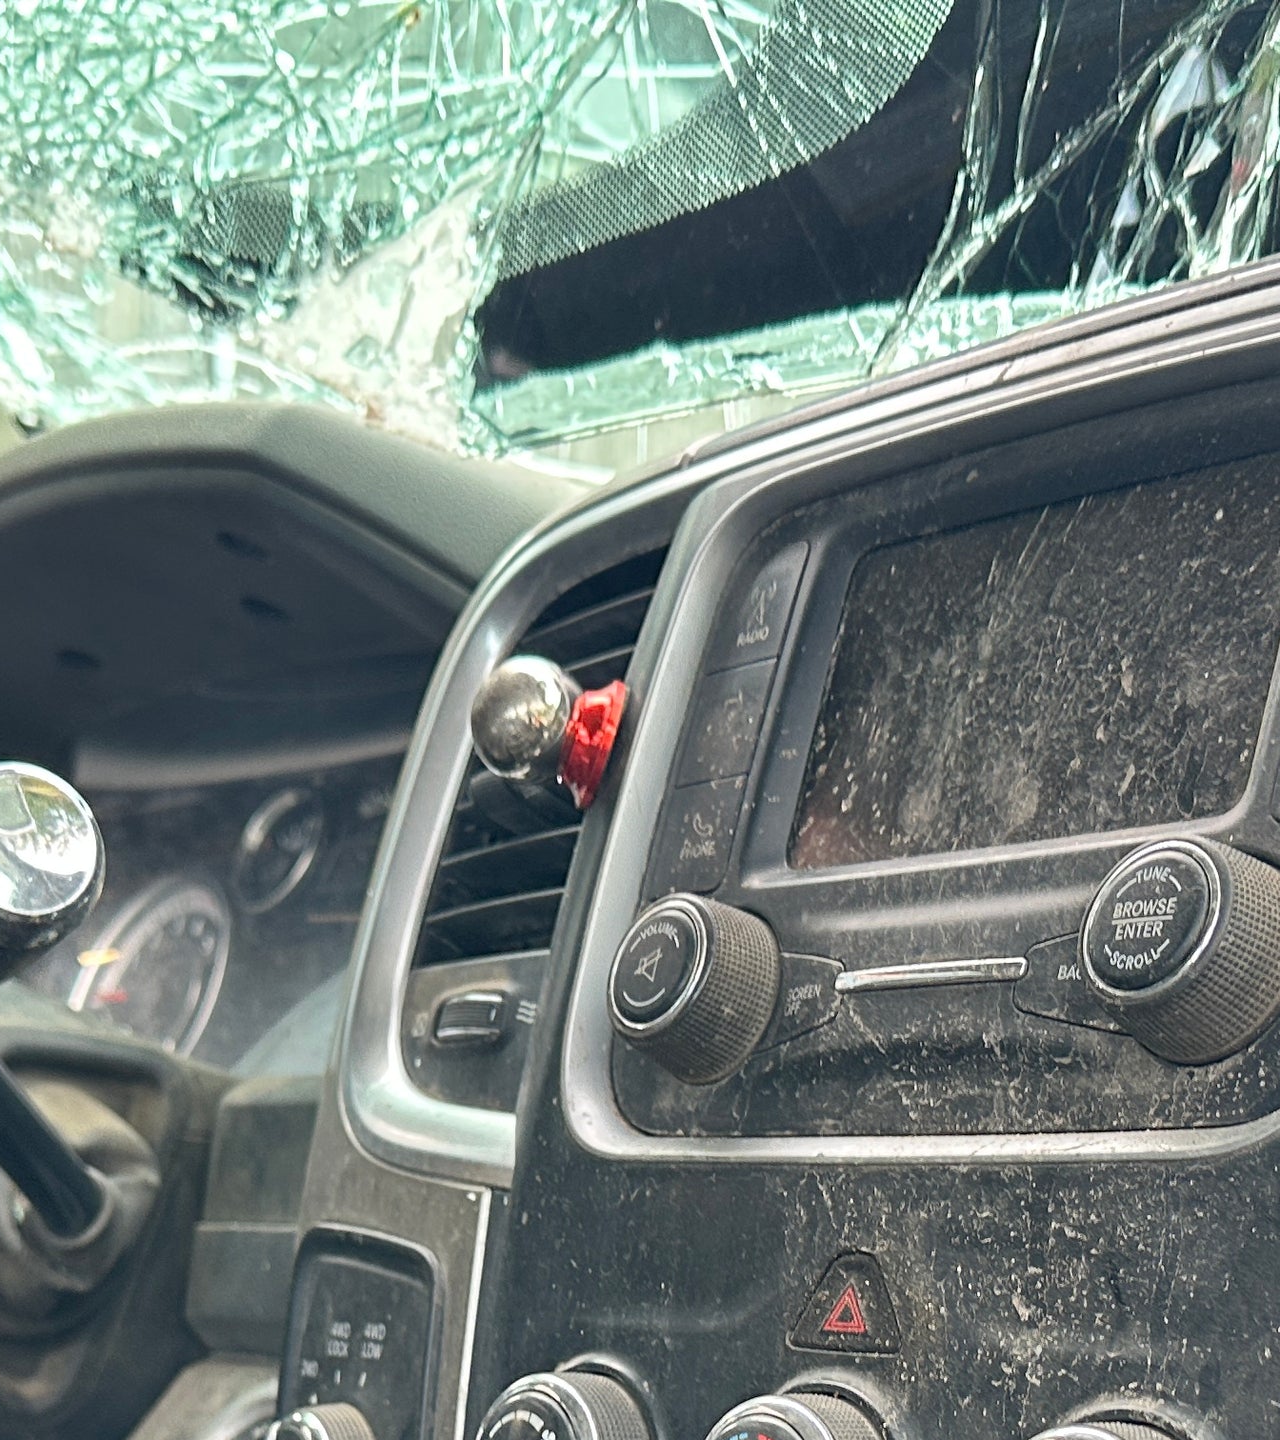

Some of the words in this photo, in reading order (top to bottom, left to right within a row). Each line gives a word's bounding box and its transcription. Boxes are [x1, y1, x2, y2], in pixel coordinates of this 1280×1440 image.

[1136, 866, 1171, 884] TUNE
[1113, 897, 1177, 919] BROWSE
[639, 922, 680, 941] VOLUME
[1115, 921, 1164, 941] ENTER
[1109, 948, 1160, 971] SCROLL
[787, 984, 821, 1001] SCREEN
